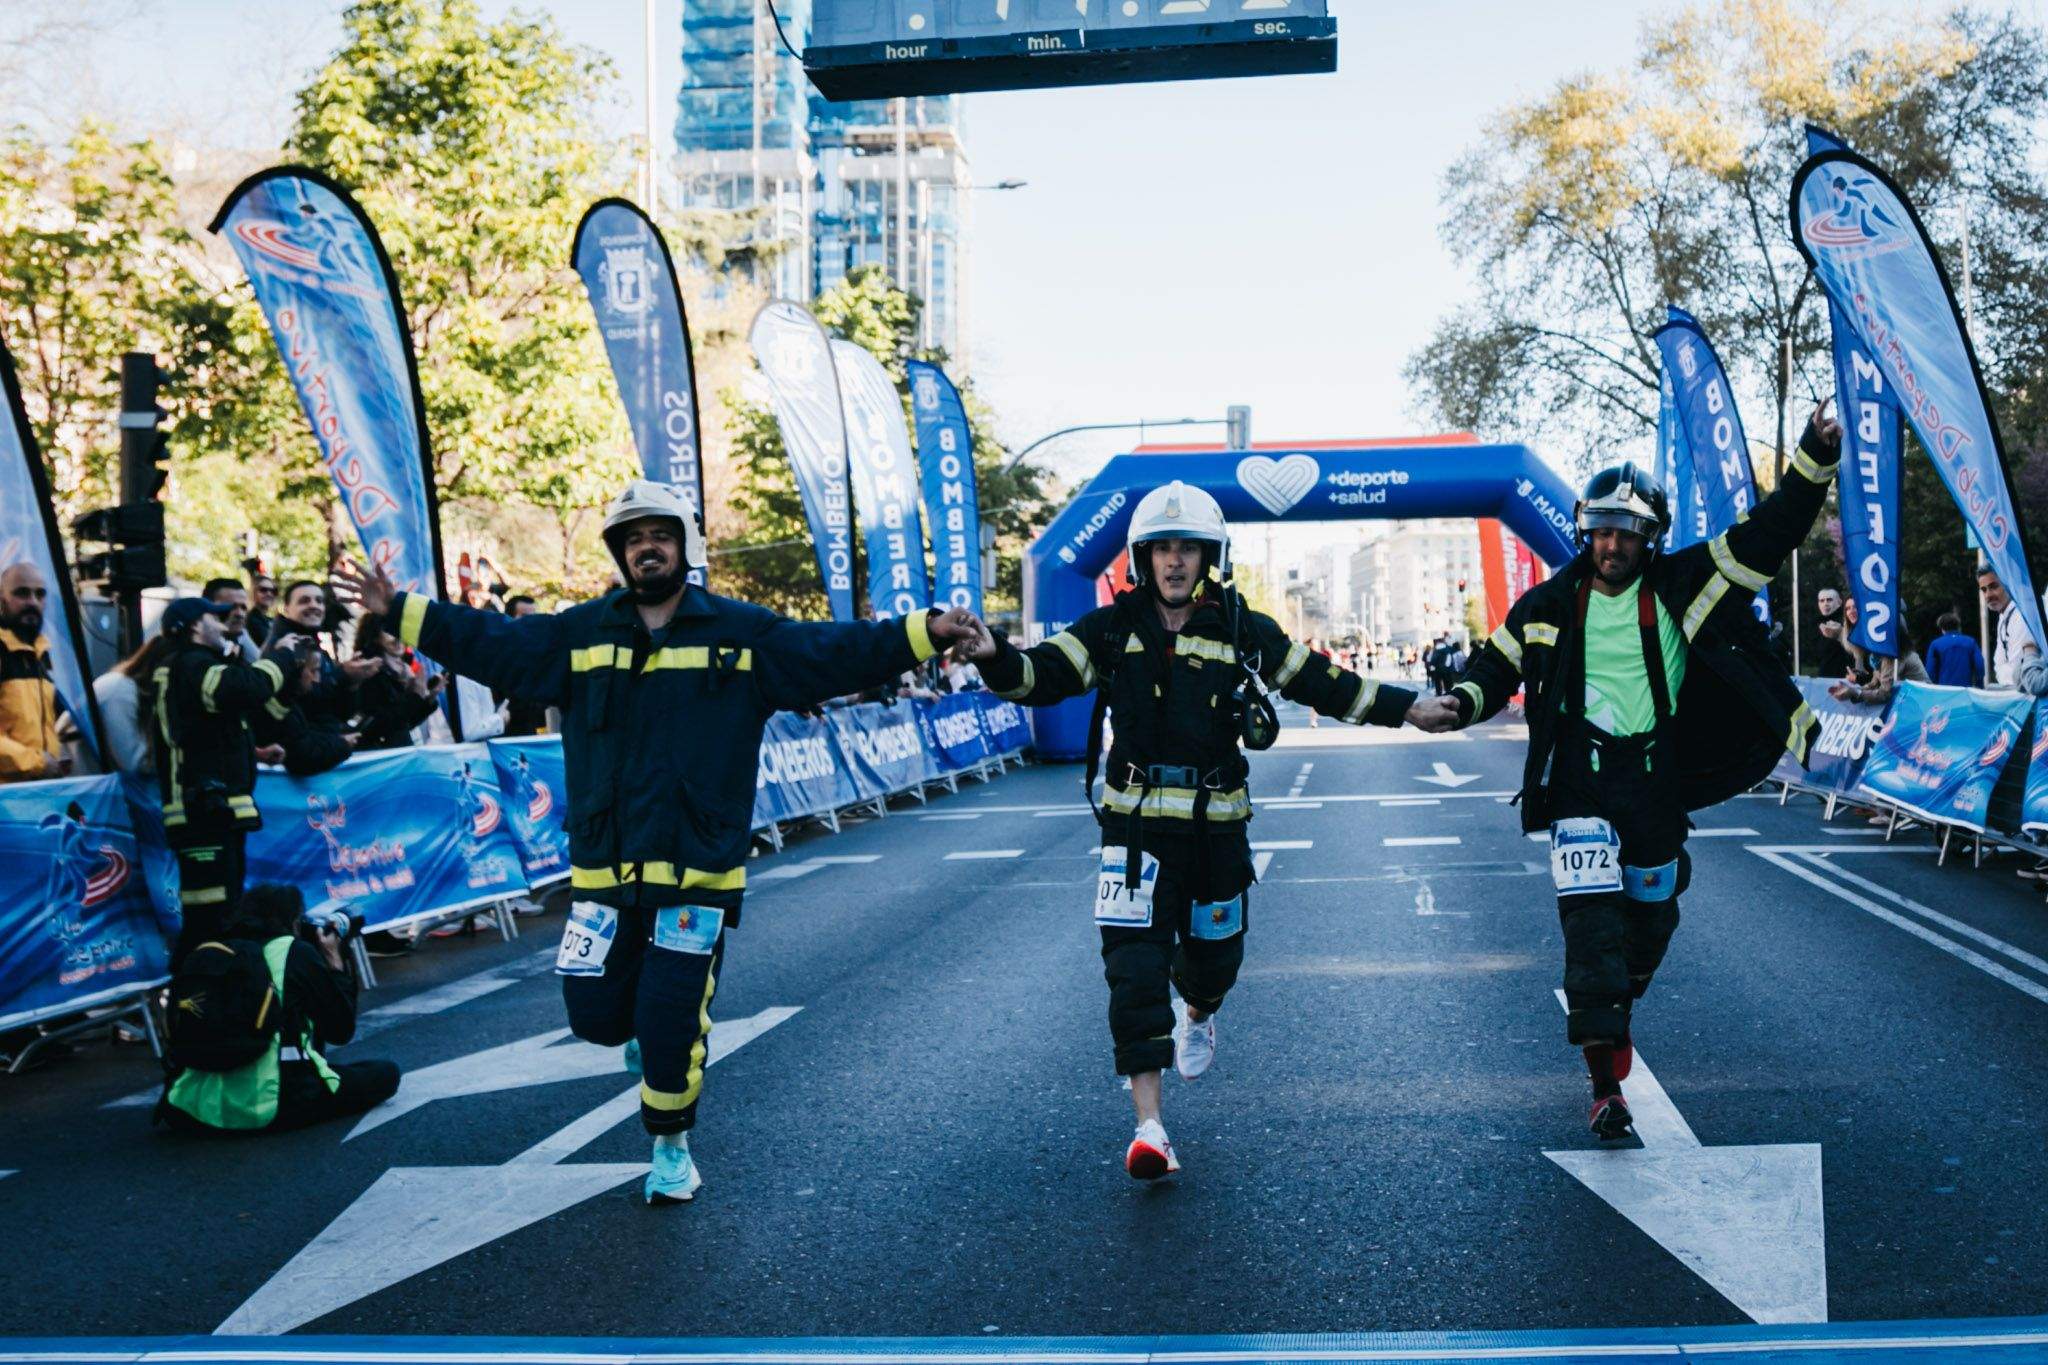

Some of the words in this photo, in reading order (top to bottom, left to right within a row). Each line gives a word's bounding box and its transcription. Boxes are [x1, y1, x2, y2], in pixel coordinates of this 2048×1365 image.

[1254, 20, 1292, 35] sec.
[885, 42, 929, 60] hour
[1027, 34, 1067, 51] min.
[1327, 470, 1409, 489] +deporte
[1328, 488, 1386, 505] +salud
[1073, 492, 1126, 548] MADRID
[1532, 494, 1578, 546] MADR
[1560, 849, 1611, 872] 1072
[1101, 880, 1135, 902] 071
[564, 930, 593, 958] 073
